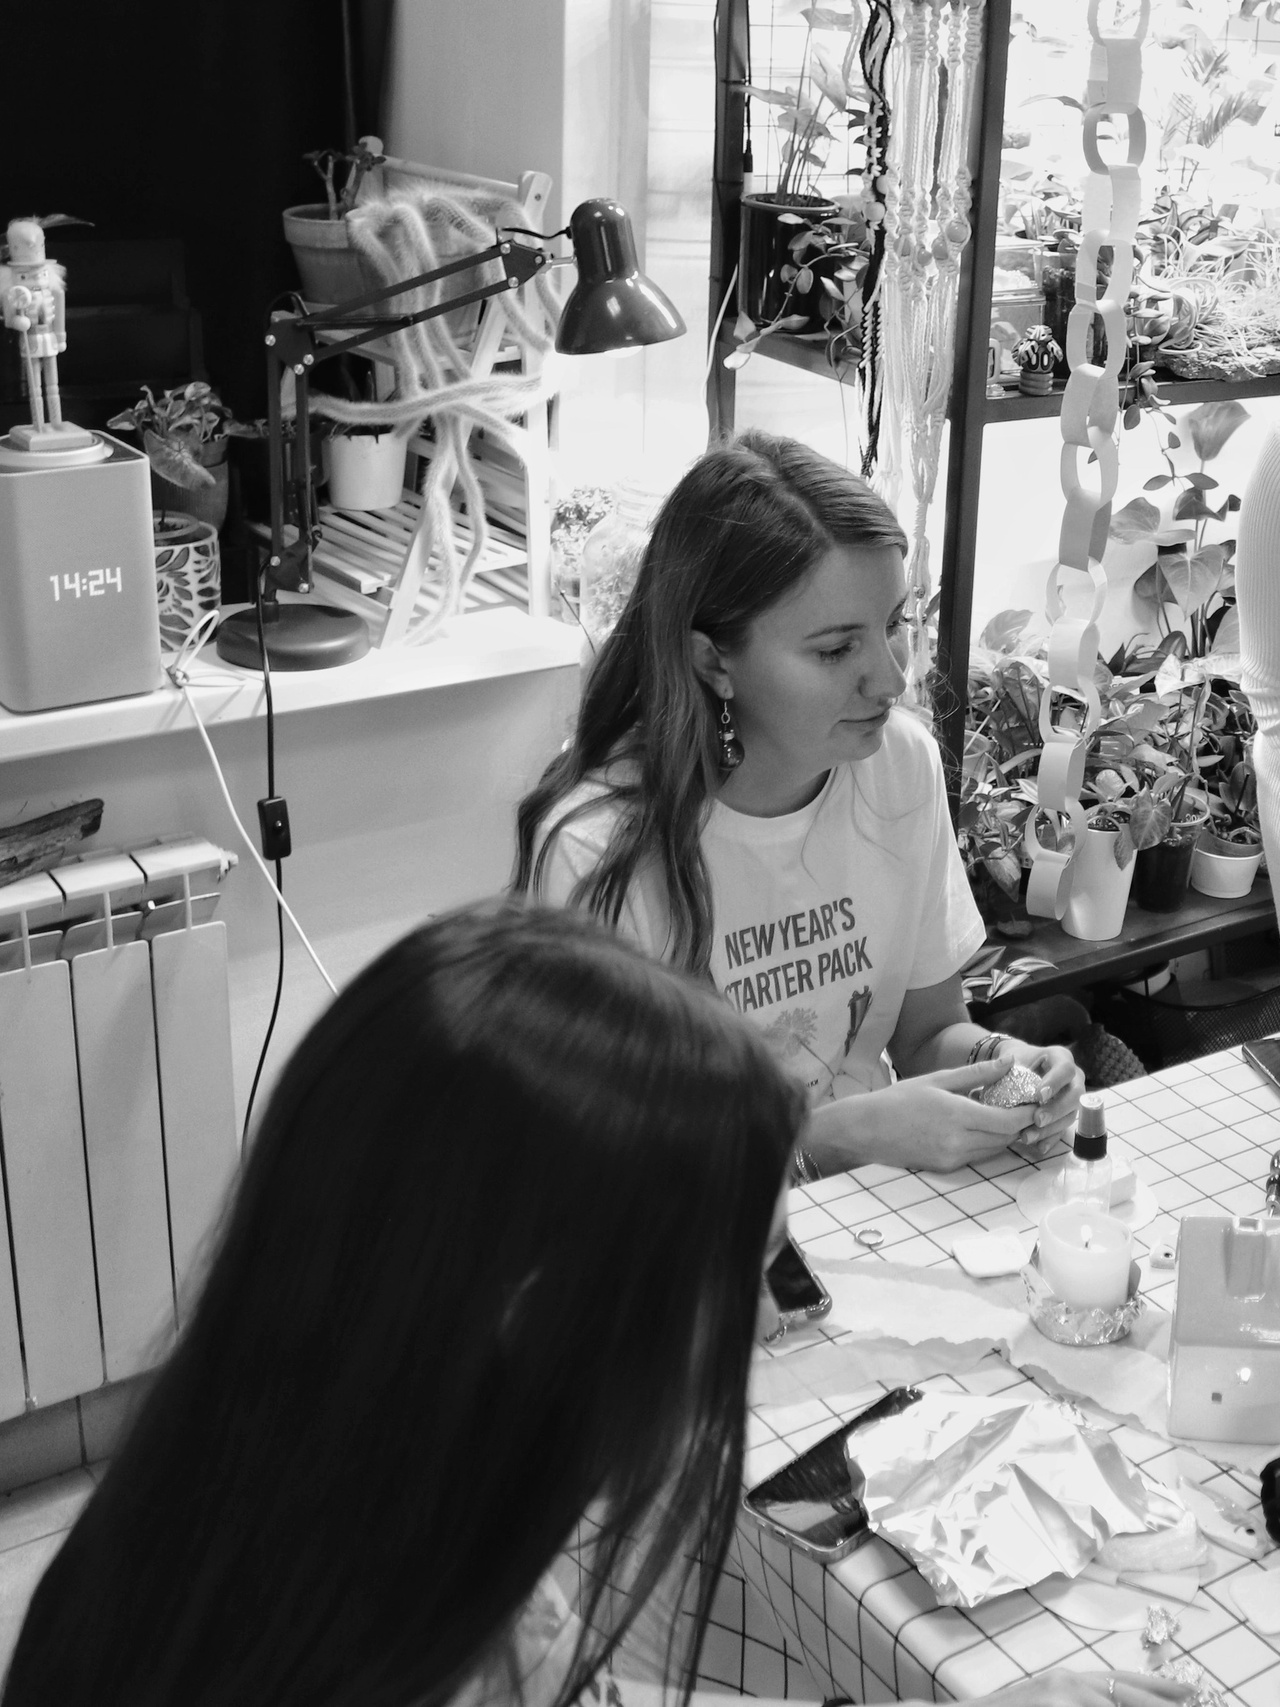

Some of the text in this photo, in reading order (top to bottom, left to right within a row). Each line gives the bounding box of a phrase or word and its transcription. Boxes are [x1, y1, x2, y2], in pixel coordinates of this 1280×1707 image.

[50, 567, 122, 601] 14:24
[725, 897, 856, 970] NEW YEAR'S
[818, 936, 873, 987] PACK
